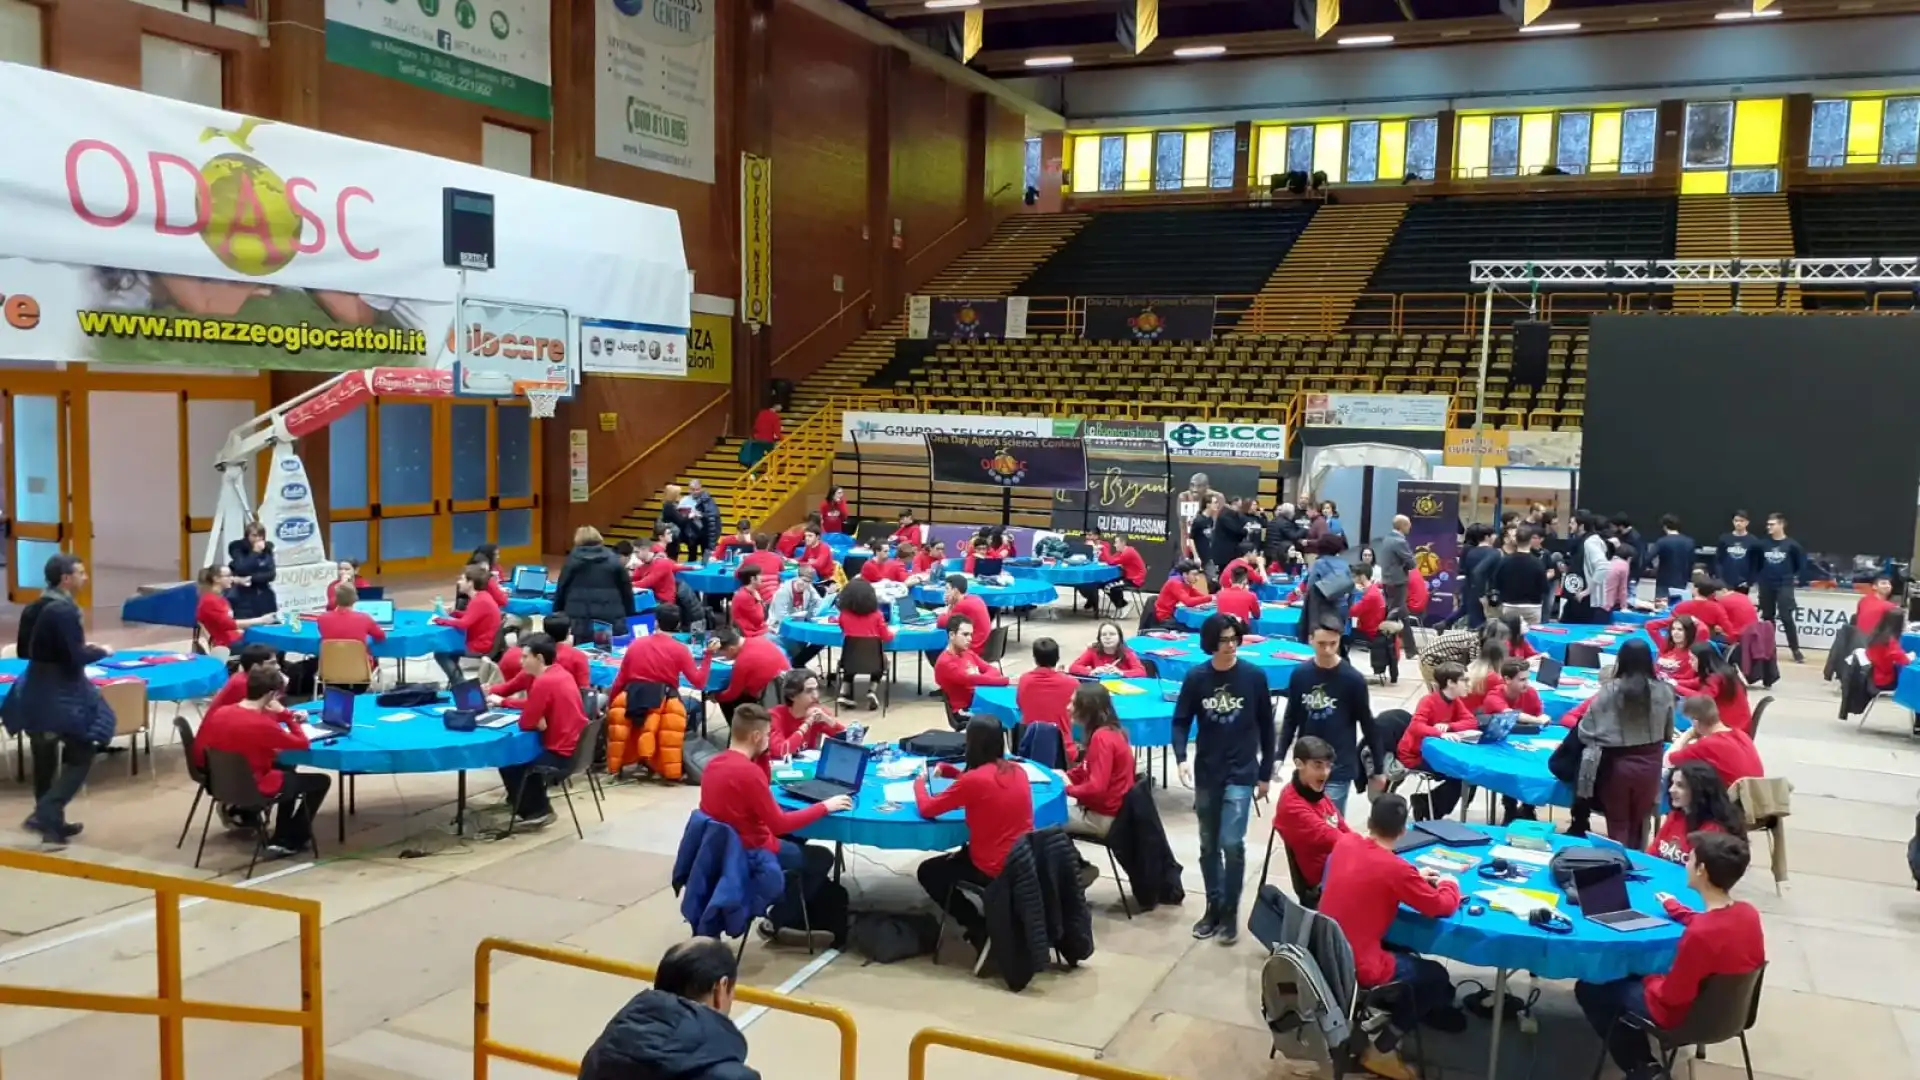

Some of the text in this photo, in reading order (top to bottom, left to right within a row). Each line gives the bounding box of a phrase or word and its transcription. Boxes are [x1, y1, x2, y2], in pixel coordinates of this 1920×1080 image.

[65, 138, 380, 265] ODASC
[78, 310, 427, 355] www.mazzeogiocattoli.it
[931, 434, 949, 444] One
[952, 436, 969, 447] Day
[1002, 438, 1039, 449] Science
[1208, 426, 1280, 441] BCC
[1235, 450, 1277, 458] Rotondo
[1795, 607, 1849, 625] ENZA
[1202, 694, 1244, 712] ODASC
